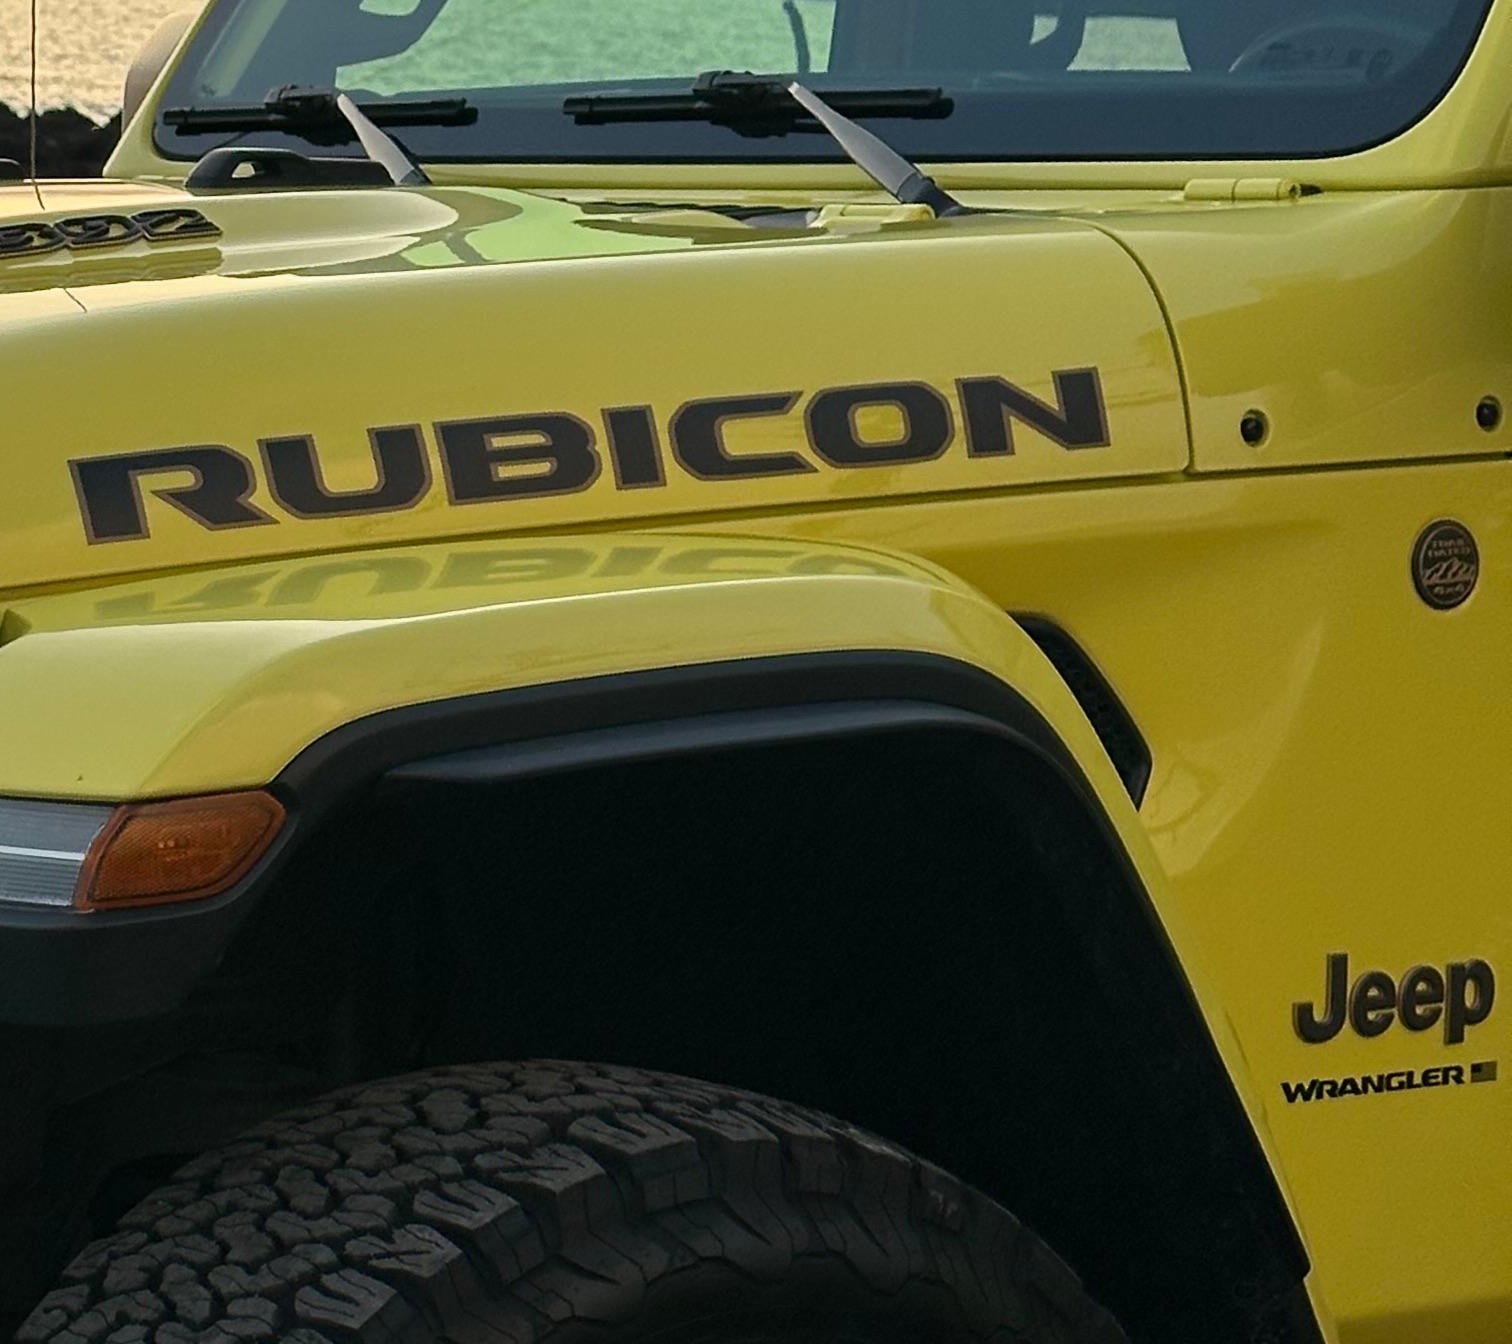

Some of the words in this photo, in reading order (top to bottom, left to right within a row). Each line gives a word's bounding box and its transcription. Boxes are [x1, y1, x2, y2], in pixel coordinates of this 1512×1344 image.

[68, 367, 1112, 546] RUBICON
[1292, 953, 1495, 1046] Jeep
[1281, 1064, 1465, 1104] WRANGLER
